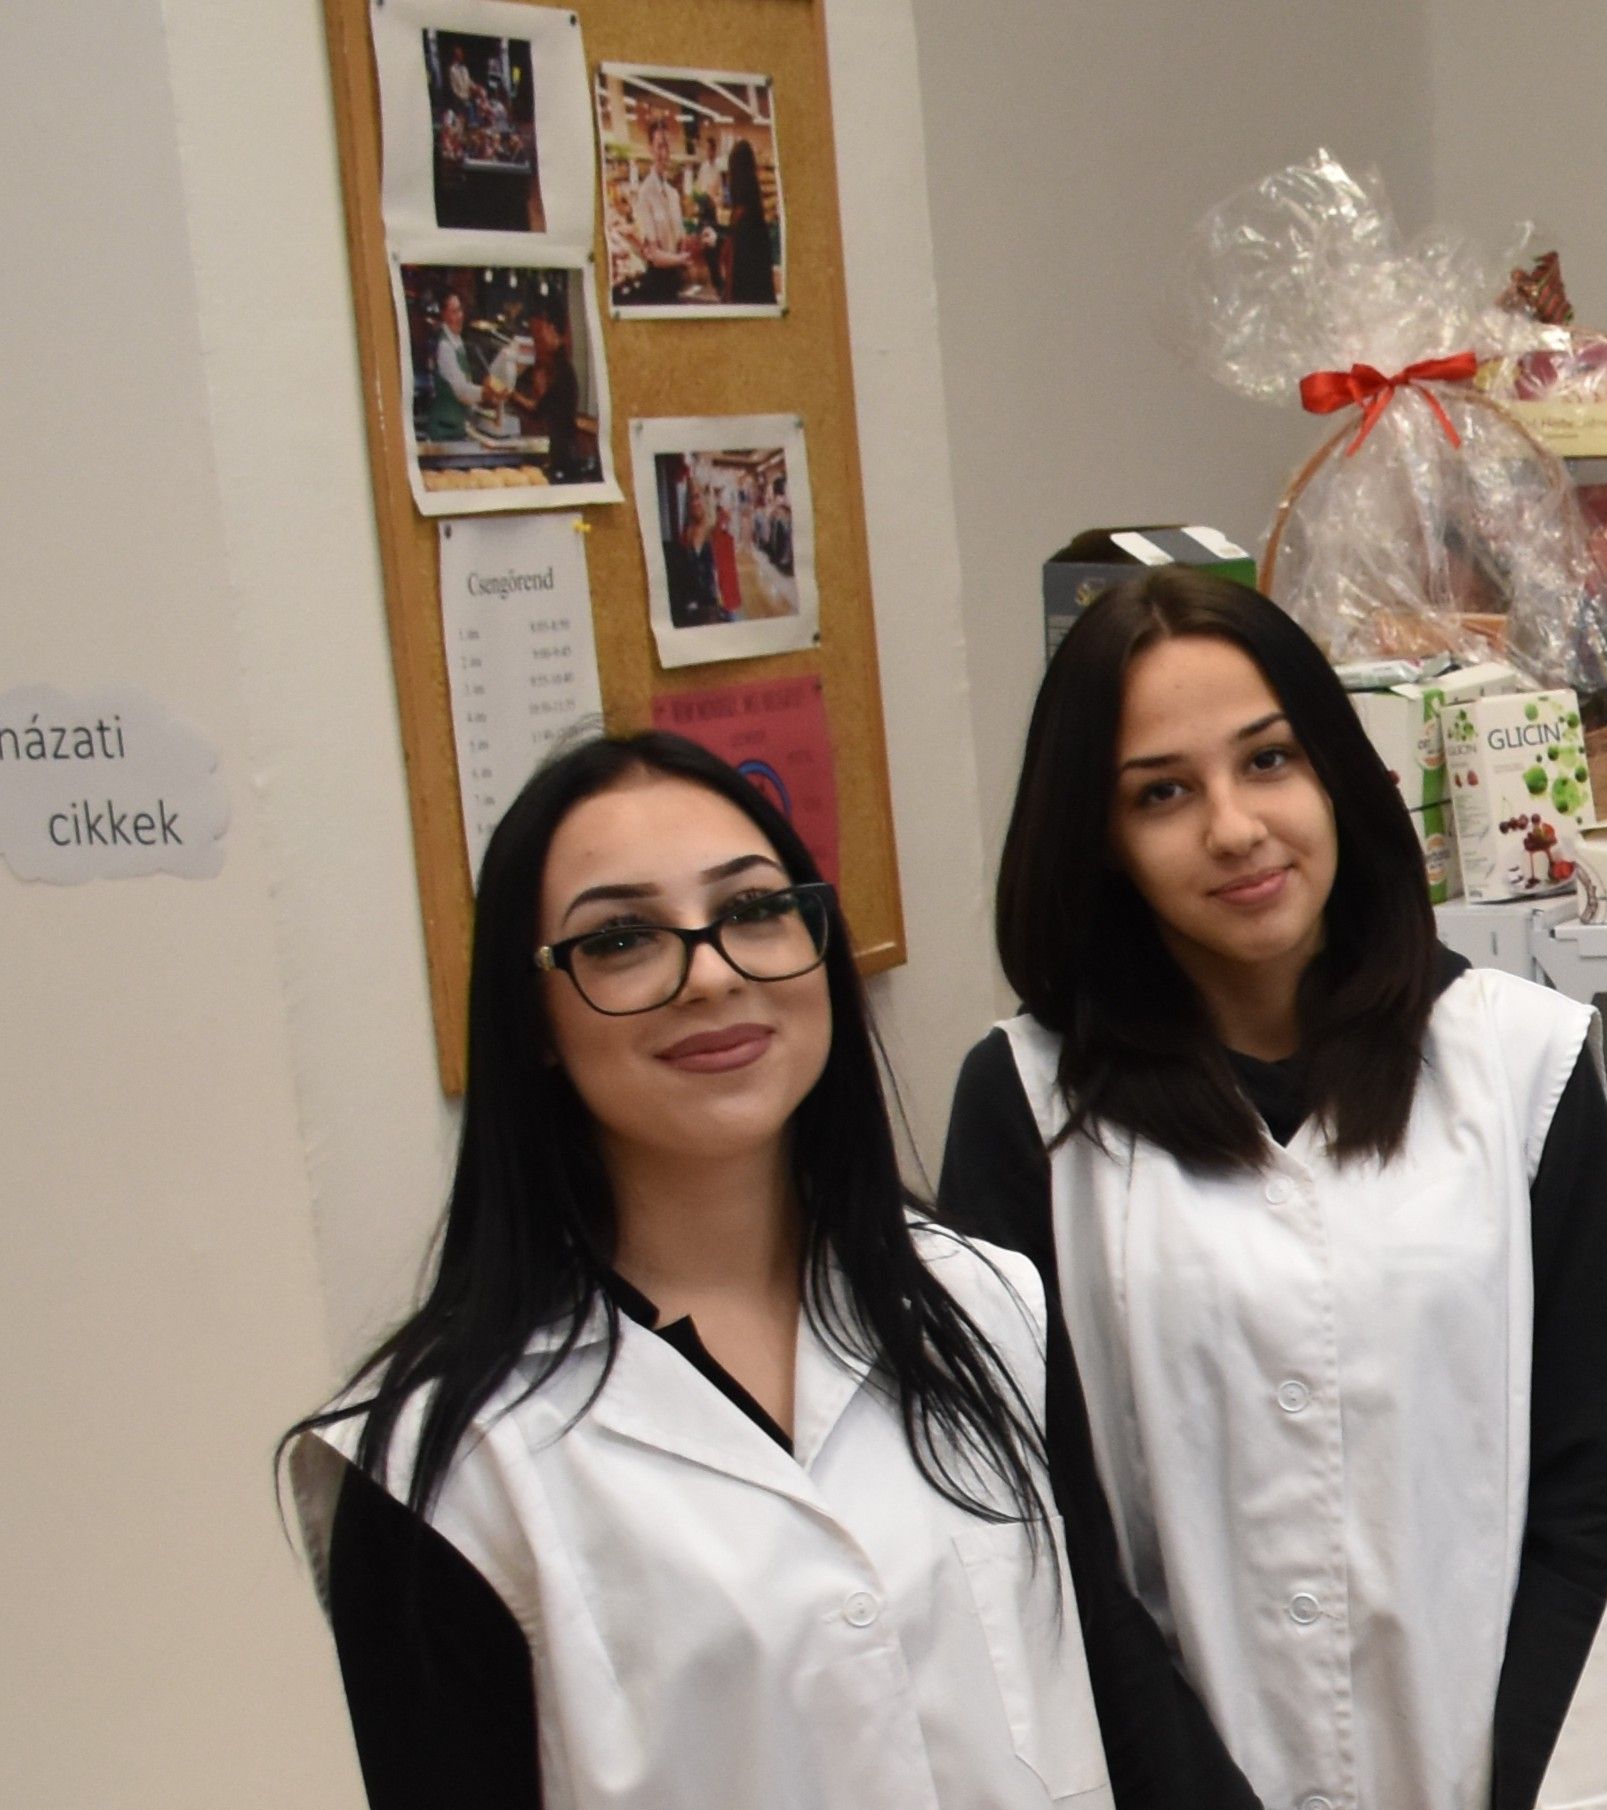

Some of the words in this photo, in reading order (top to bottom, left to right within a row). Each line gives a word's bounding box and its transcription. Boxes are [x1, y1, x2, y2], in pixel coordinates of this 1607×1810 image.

[467, 566, 554, 600] Csengőrend
[1487, 722, 1561, 750] GLICIN
[49, 799, 183, 846] cikkek
